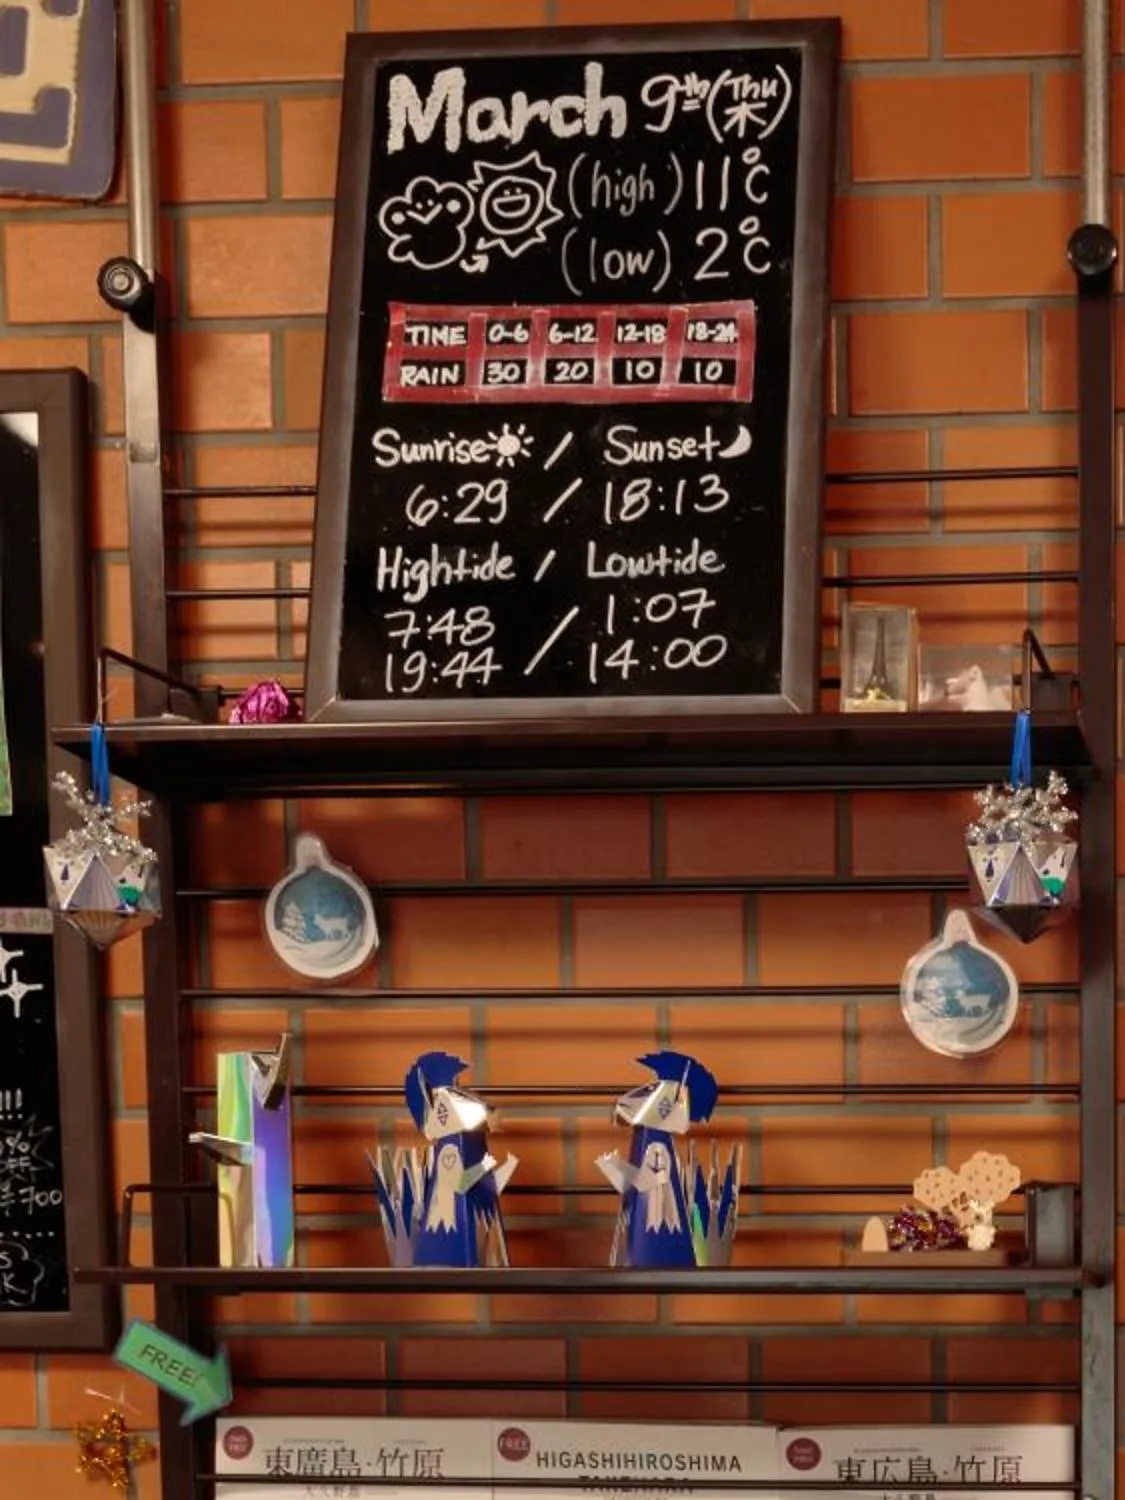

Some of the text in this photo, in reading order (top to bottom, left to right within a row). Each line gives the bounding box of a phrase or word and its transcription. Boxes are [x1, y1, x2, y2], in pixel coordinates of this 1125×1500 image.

[387, 61, 629, 154] March
[405, 324, 467, 346] TIME
[400, 360, 723, 386] RAIN 30 20 10 10
[372, 426, 490, 467] Sunrise
[604, 424, 720, 465] Sunset
[406, 478, 509, 527] 6:29
[604, 474, 730, 524] 18:13
[377, 541, 516, 601] Hightide
[588, 538, 725, 579] Lowtide
[384, 606, 496, 649] 7:48
[607, 589, 715, 635] 1:07
[384, 634, 727, 693] 19:44 14:00
[537, 1451, 742, 1473] HIGASHIHIROSHIMA
